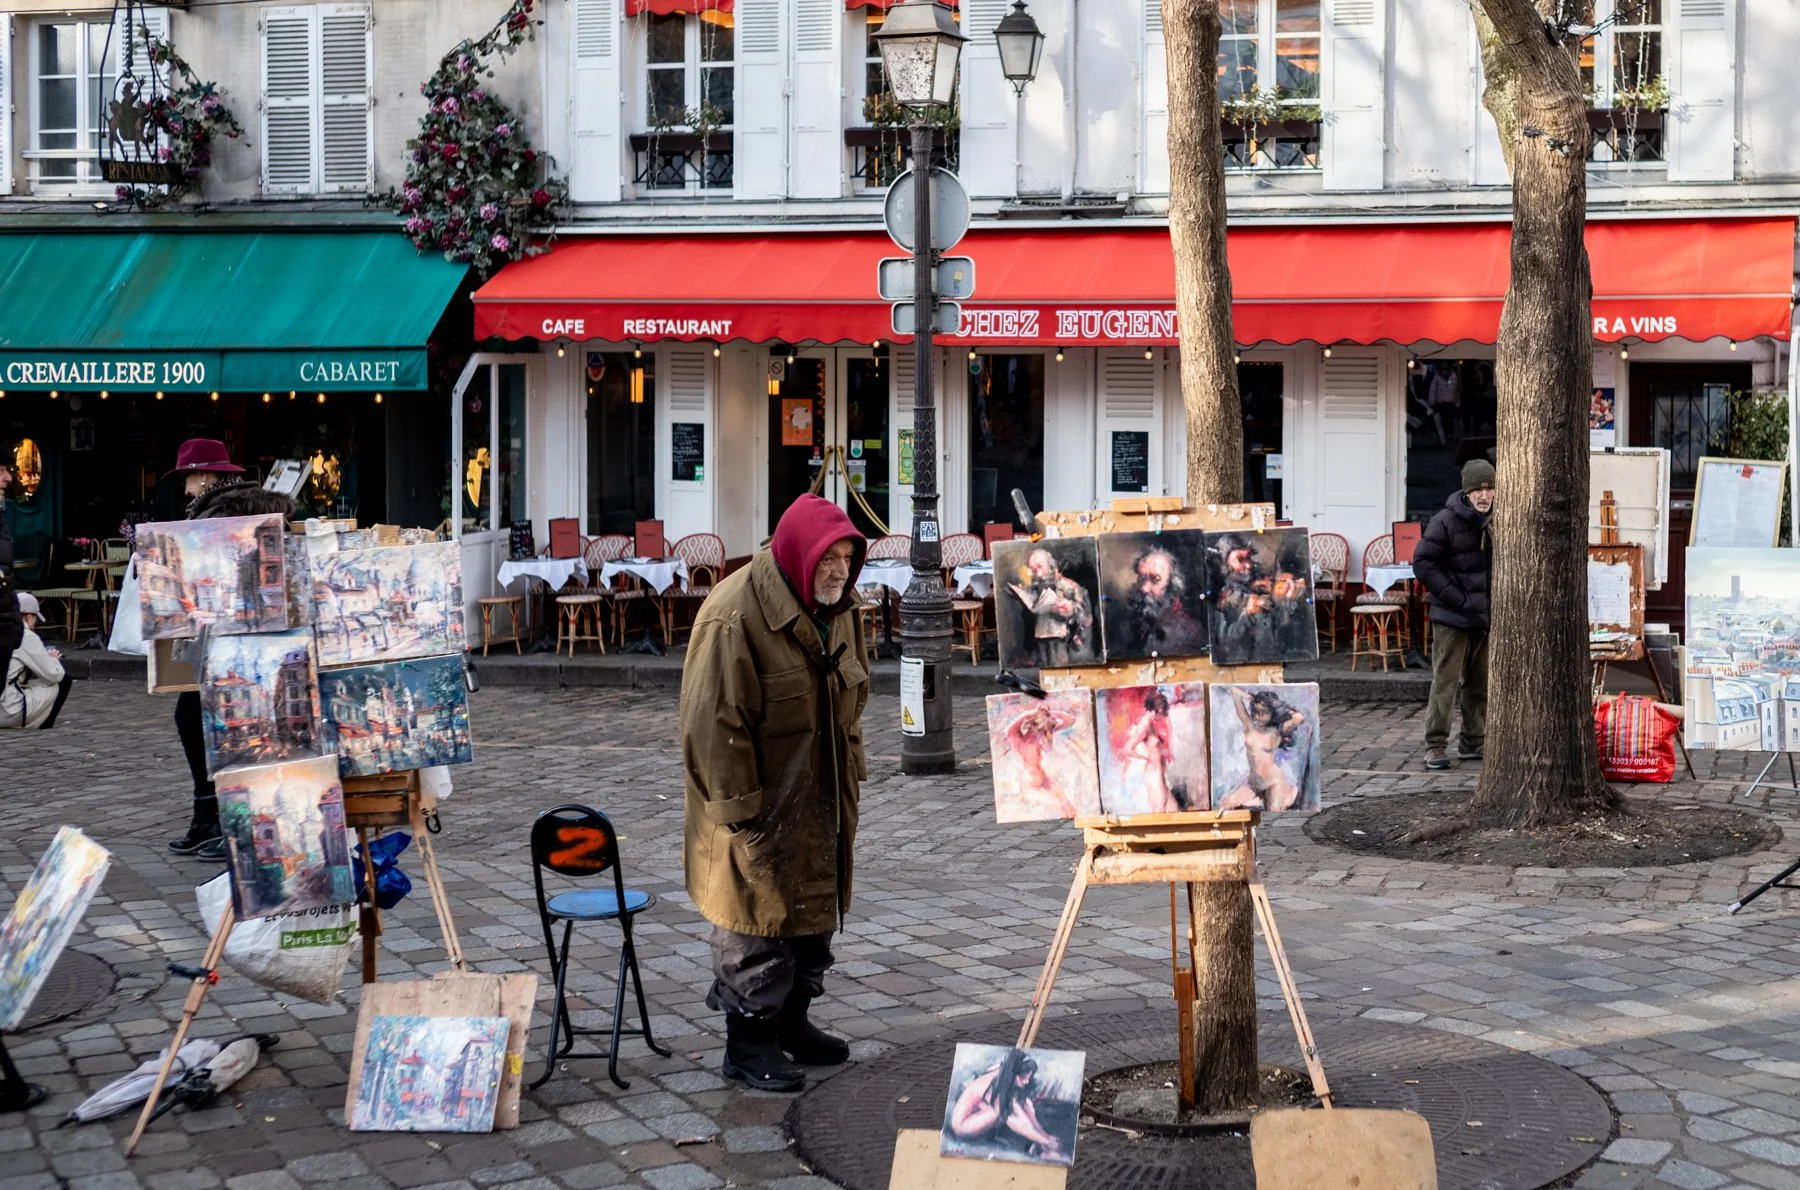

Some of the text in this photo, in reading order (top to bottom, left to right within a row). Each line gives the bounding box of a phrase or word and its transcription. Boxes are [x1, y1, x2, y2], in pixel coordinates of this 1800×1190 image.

[541, 319, 732, 335] CAFE RESTAURANT
[955, 310, 1180, 338] CHEZ EUGEN
[1611, 317, 1628, 334] A
[1630, 316, 1677, 334] VINS
[6, 362, 156, 384] CREMAILLERE
[162, 362, 205, 384] 1900
[300, 361, 399, 382] CABARET
